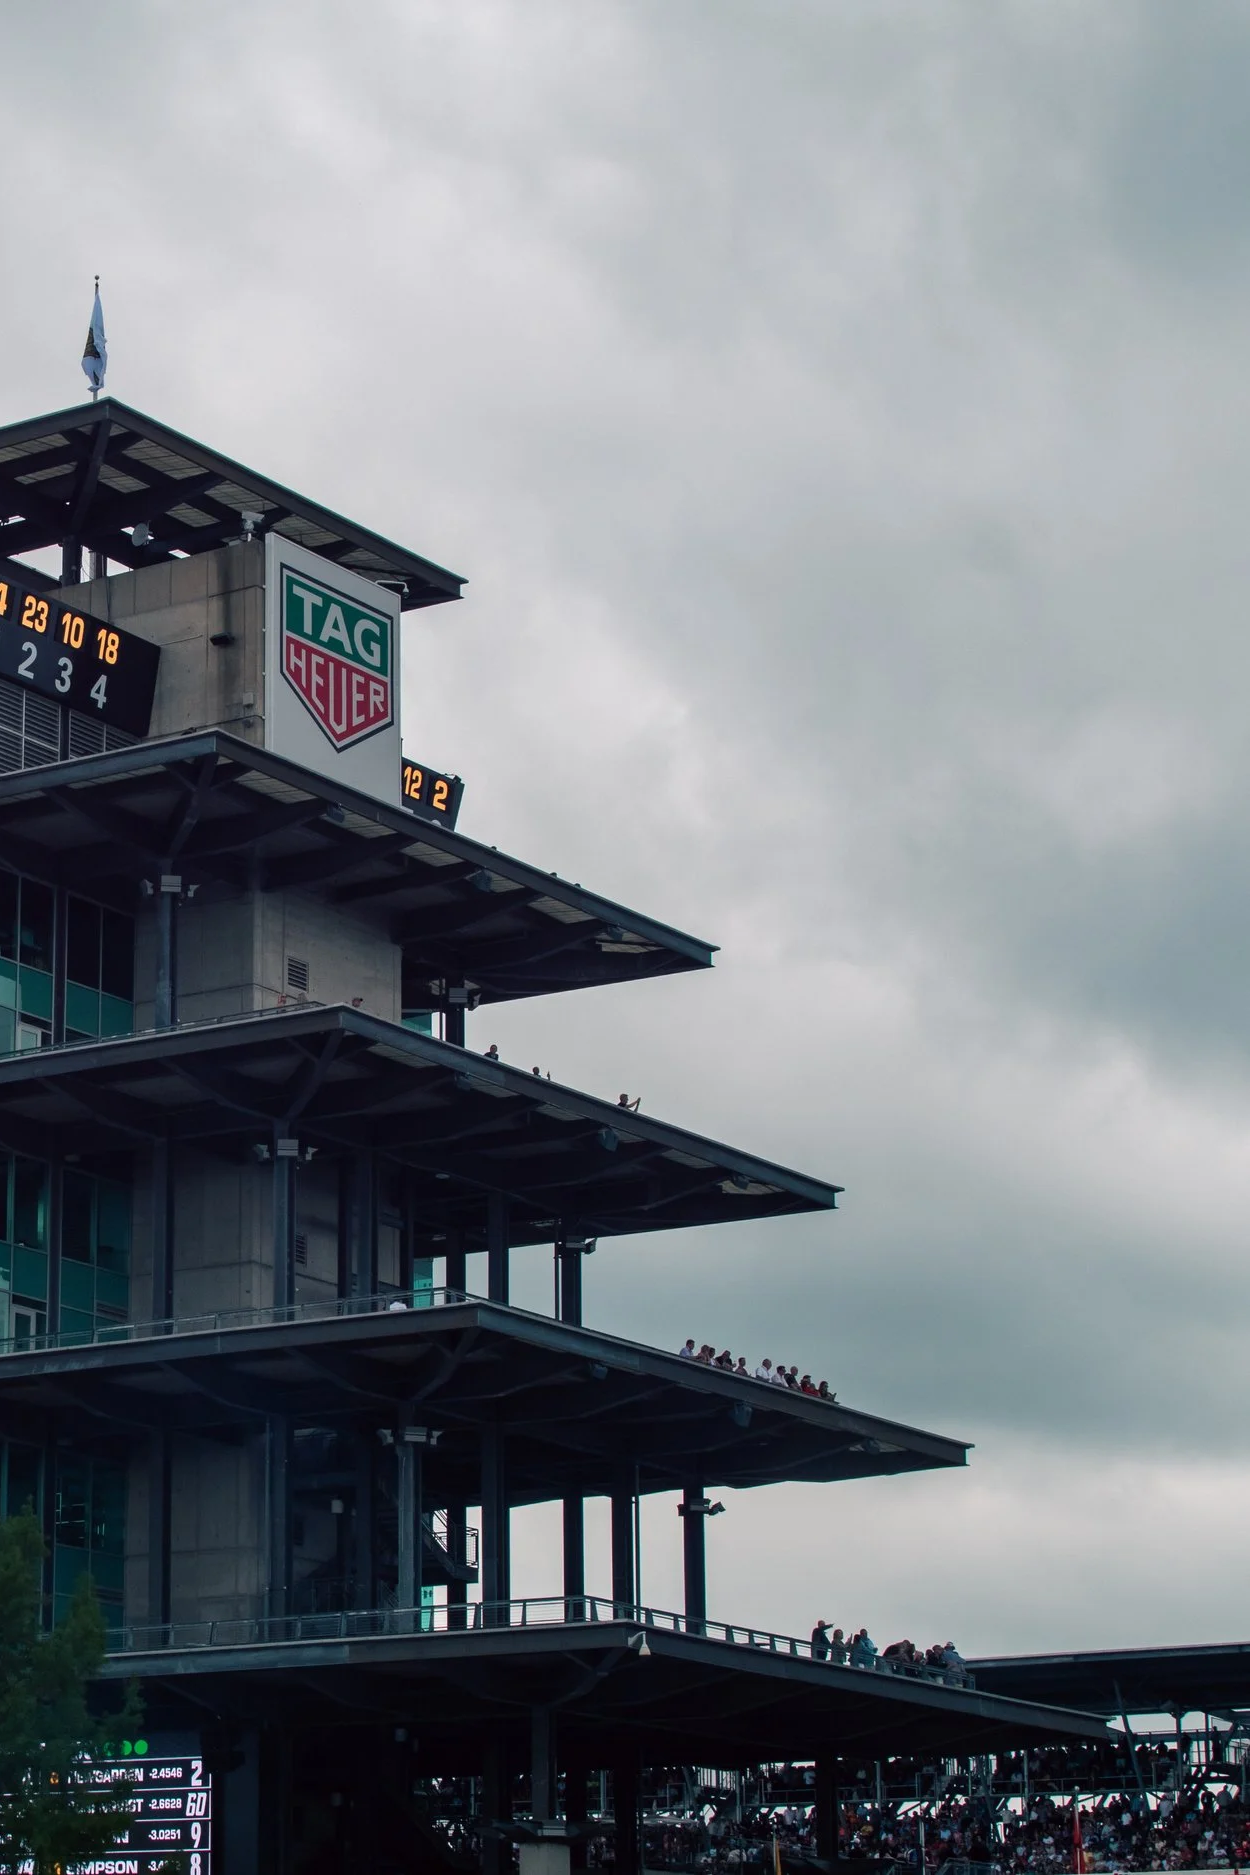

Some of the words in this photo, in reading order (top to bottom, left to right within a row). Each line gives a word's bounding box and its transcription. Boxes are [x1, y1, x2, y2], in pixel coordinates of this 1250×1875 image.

[21, 595, 49, 633] 23
[61, 612, 85, 649] 10
[97, 628, 120, 665] 18
[292, 583, 381, 668] TAG
[17, 641, 38, 680] 2
[54, 656, 73, 693] 3
[90, 674, 107, 709] 4
[289, 643, 385, 735] HEUER
[403, 766, 423, 800] 12
[432, 780, 449, 811] 2
[149, 1767, 183, 1779] -2.4546
[190, 1760, 203, 1787] 2
[148, 1798, 183, 1810] -2.6628
[185, 1791, 208, 1817] 60
[148, 1829, 182, 1841] -3.0251
[190, 1821, 202, 1848] 9
[190, 1852, 202, 1875] 8
